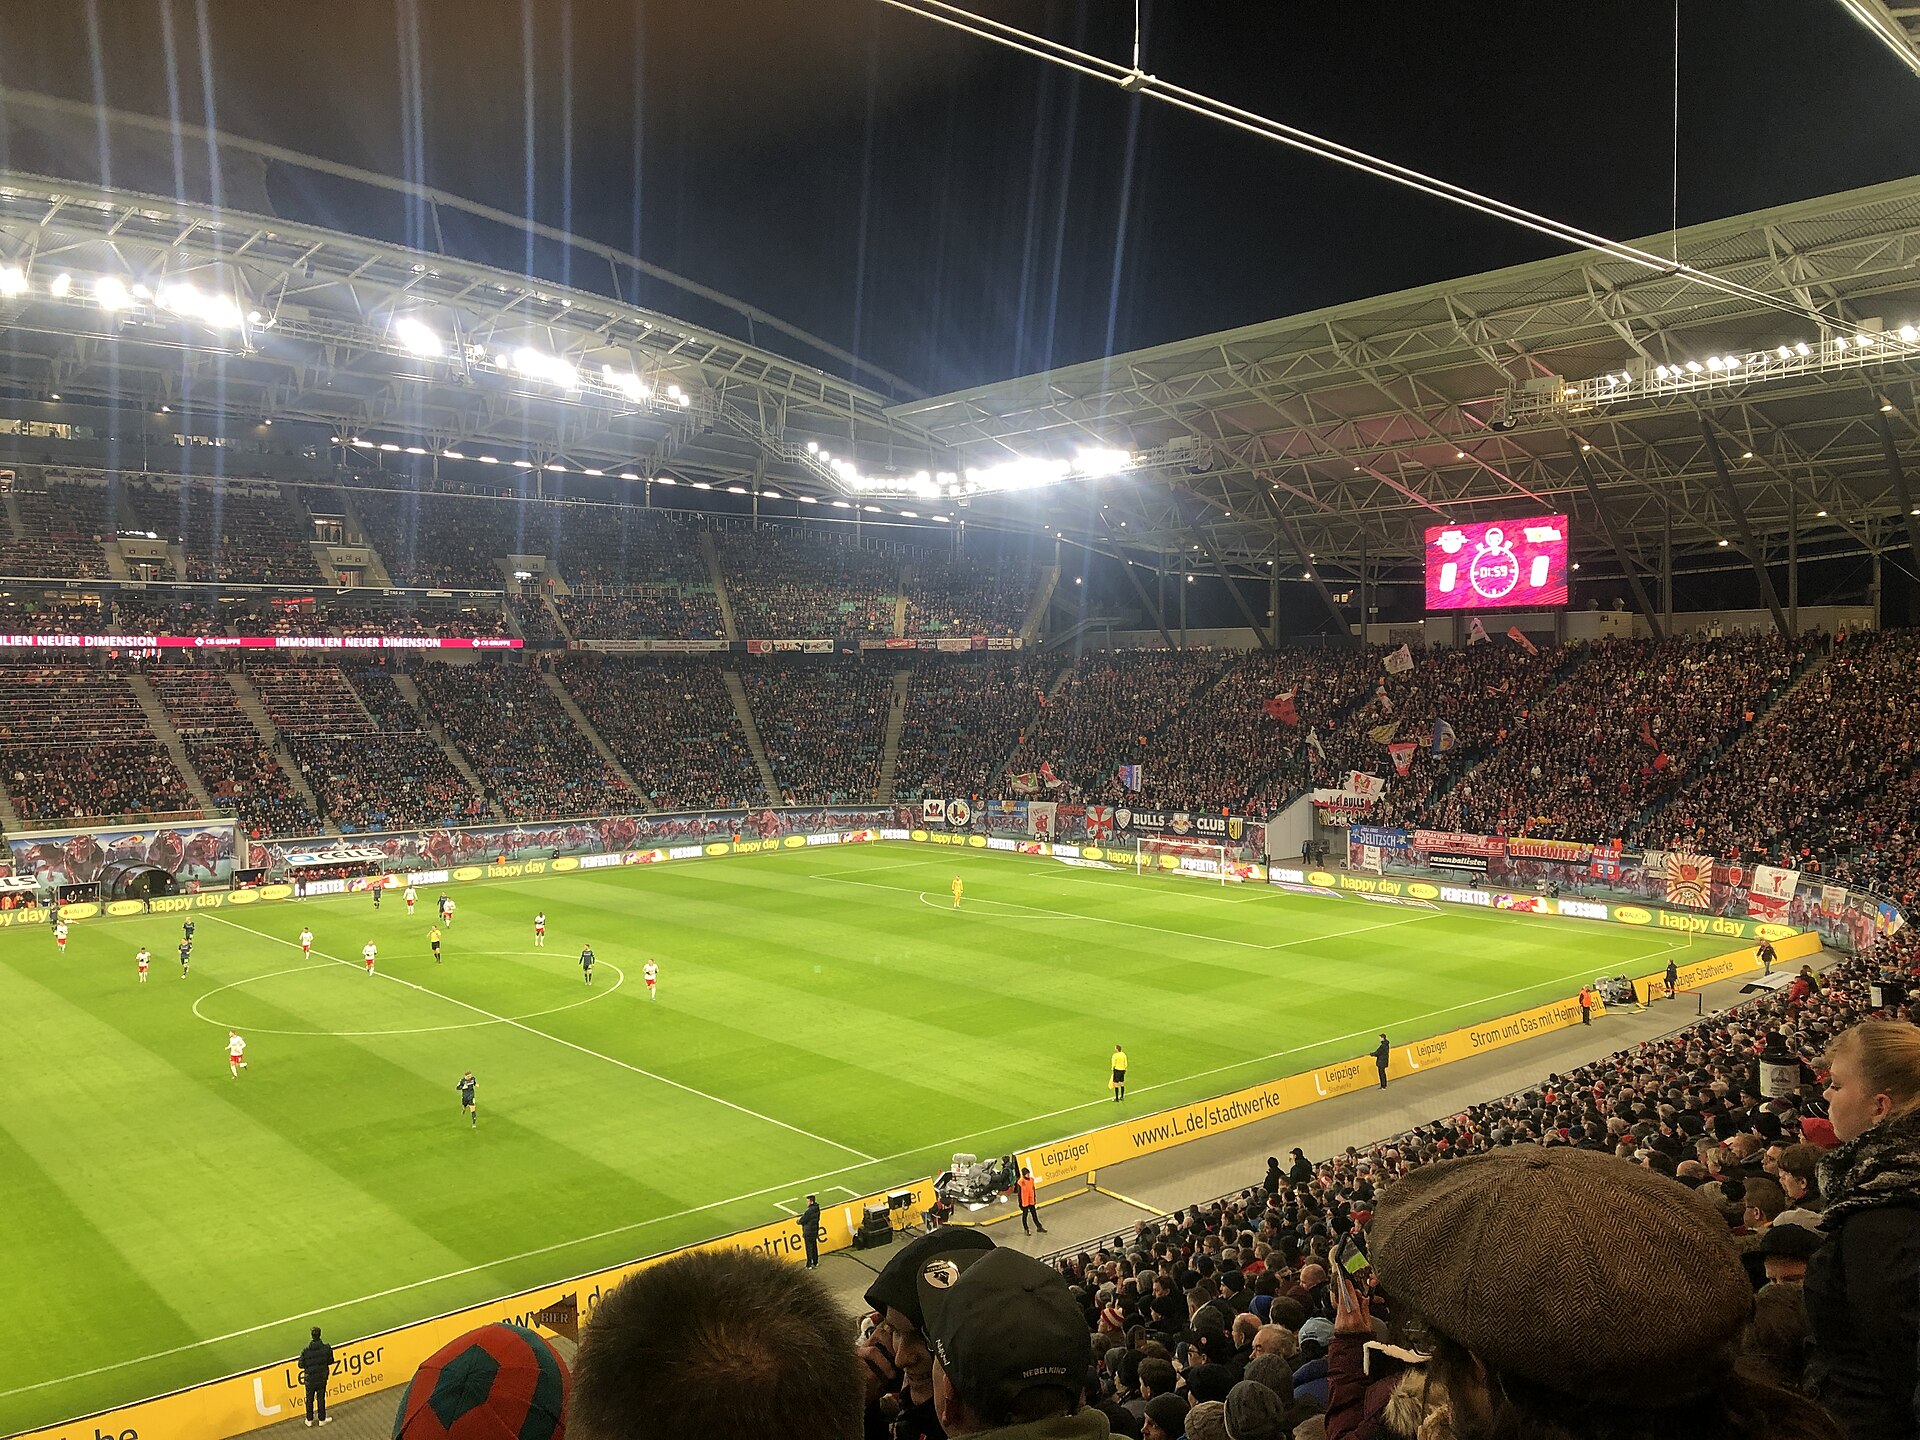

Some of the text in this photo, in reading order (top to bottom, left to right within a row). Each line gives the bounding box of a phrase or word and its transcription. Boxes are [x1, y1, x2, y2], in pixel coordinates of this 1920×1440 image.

[37, 636, 80, 647] NEUER
[84, 636, 157, 648] DIMENSION
[275, 637, 442, 648] IMMOBILIEN NEUER DIMENSION
[1344, 797, 1366, 808] BULLS
[1133, 813, 1226, 832] BULLS CLUB
[733, 841, 762, 853] happy
[763, 837, 780, 850] day
[930, 831, 966, 846] happy day
[1360, 829, 1396, 848] DELITZSCH
[318, 849, 382, 860] CELLS
[1106, 849, 1133, 865] happy
[1135, 851, 1153, 867] day
[1510, 844, 1577, 861] BENNEWITZ
[1593, 848, 1620, 859] BLOCK
[487, 860, 547, 878] happy day
[1430, 856, 1487, 867] rasenballisten
[1341, 875, 1377, 892] happy
[1379, 878, 1402, 895] day
[196, 890, 224, 908] day
[1440, 887, 1490, 906] PERFEKTES
[17, 907, 49, 924] day
[1659, 910, 1746, 938] happy day
[1695, 960, 1734, 981] Stadtwerke
[1470, 1029, 1502, 1048] Strom
[1502, 1021, 1520, 1038] und
[1520, 1018, 1538, 1033] Gas
[1539, 1011, 1554, 1026] mit
[1416, 1040, 1448, 1057] Leipziger
[1325, 1064, 1361, 1083] Leipziger
[1132, 1091, 1281, 1148] www.L.de/stadtwerke
[1040, 1142, 1090, 1167] Leipziger
[1045, 1164, 1078, 1180] Stadtwerke
[541, 1312, 568, 1324] BIER
[285, 1346, 385, 1390] Leziger
[1022, 1366, 1067, 1379] NEBELKIND
